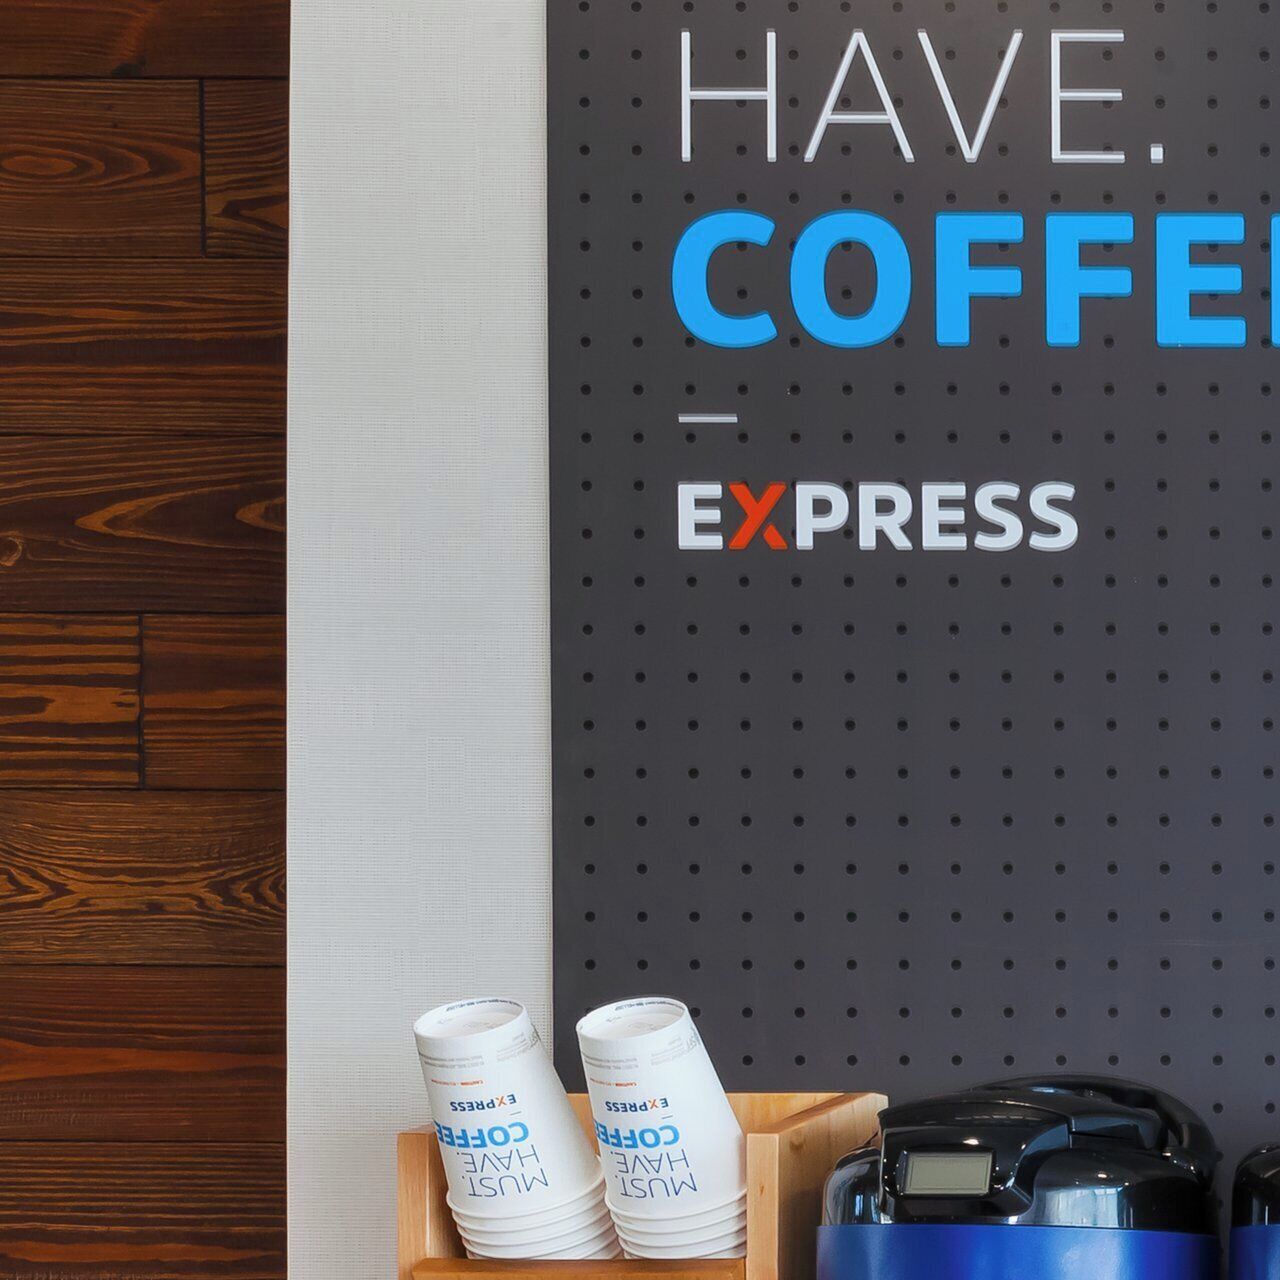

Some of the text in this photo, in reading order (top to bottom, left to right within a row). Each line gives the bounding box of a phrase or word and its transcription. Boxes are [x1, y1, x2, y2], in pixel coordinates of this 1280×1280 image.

[680, 28, 1164, 163] HAVE.
[677, 481, 1080, 552] EXPRESS
[449, 1093, 517, 1112] EXPRESS
[605, 1097, 669, 1113] EXPRESS
[594, 1119, 680, 1149] COFFE
[457, 1144, 540, 1173] HAVE.
[610, 1148, 690, 1174] HAVE.
[462, 1168, 548, 1197] MUST.
[615, 1172, 697, 1199] MUST.
